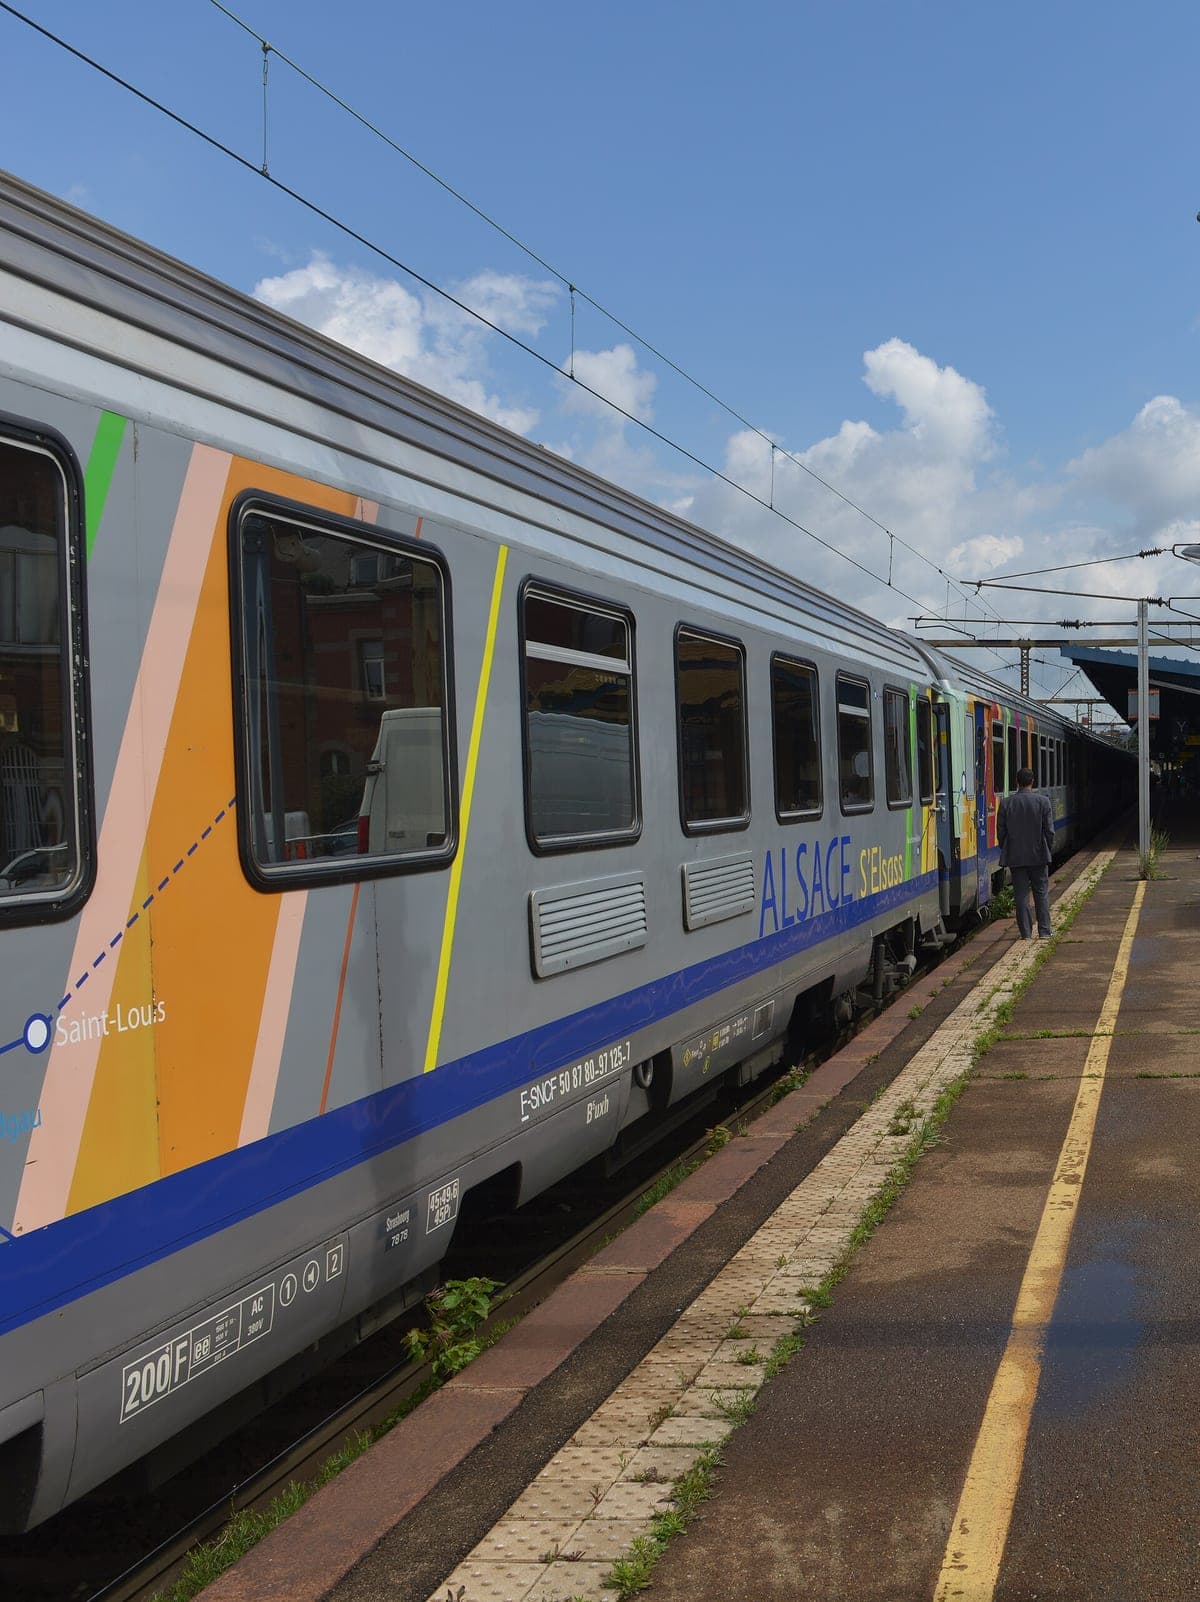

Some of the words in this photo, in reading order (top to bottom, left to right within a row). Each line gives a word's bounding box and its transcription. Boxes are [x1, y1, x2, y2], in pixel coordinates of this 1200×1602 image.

[759, 836, 853, 938] ALSACE
[859, 846, 903, 898] S'Elsass
[55, 998, 166, 1047] Saint-Louis
[520, 1077, 557, 1118] F-SNCF
[559, 1071, 570, 1095] 50
[572, 1064, 582, 1089] 87
[331, 1253, 338, 1273] 2
[251, 1296, 263, 1316] AC
[285, 1280, 291, 1300] 1
[125, 1352, 170, 1413] 200
[174, 1340, 188, 1383] F
